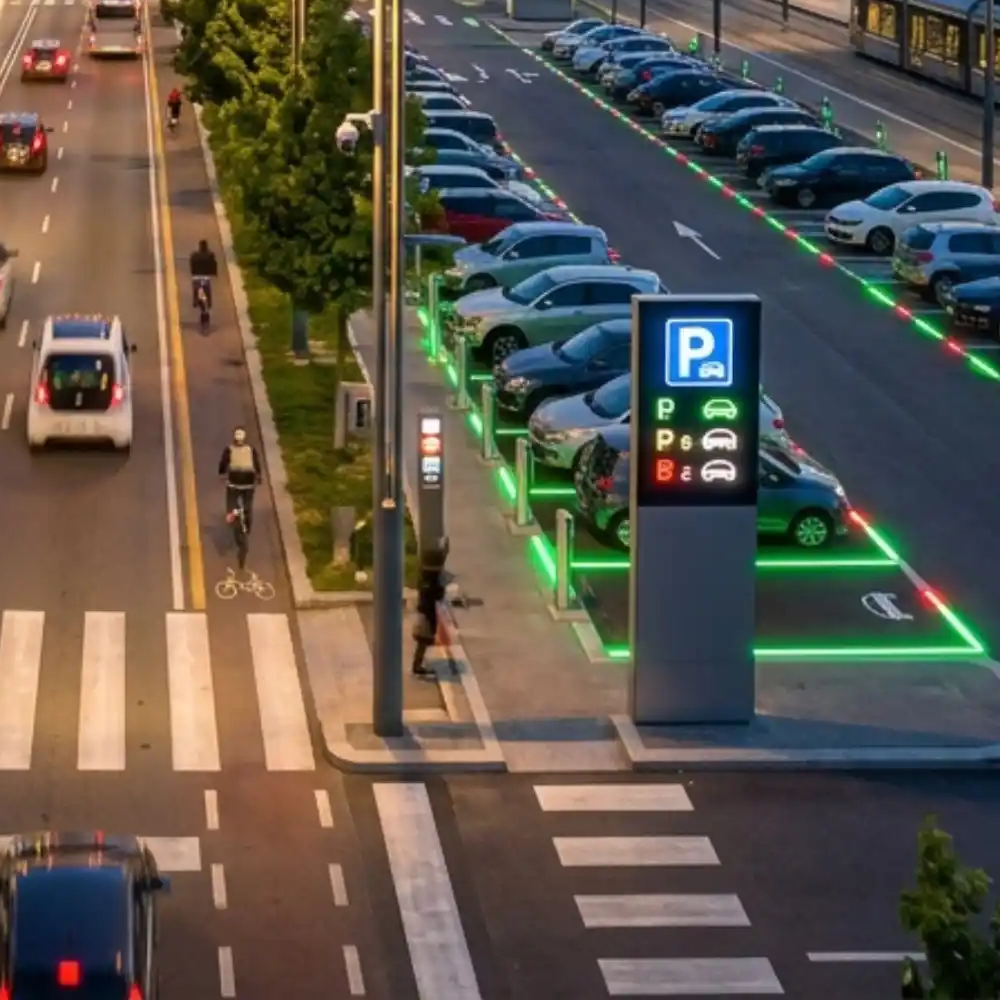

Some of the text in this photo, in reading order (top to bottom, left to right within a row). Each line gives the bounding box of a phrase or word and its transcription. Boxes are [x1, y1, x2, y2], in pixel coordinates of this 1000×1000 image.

[678, 326, 715, 378] P
[657, 397, 675, 420] P
[656, 428, 675, 452] P
